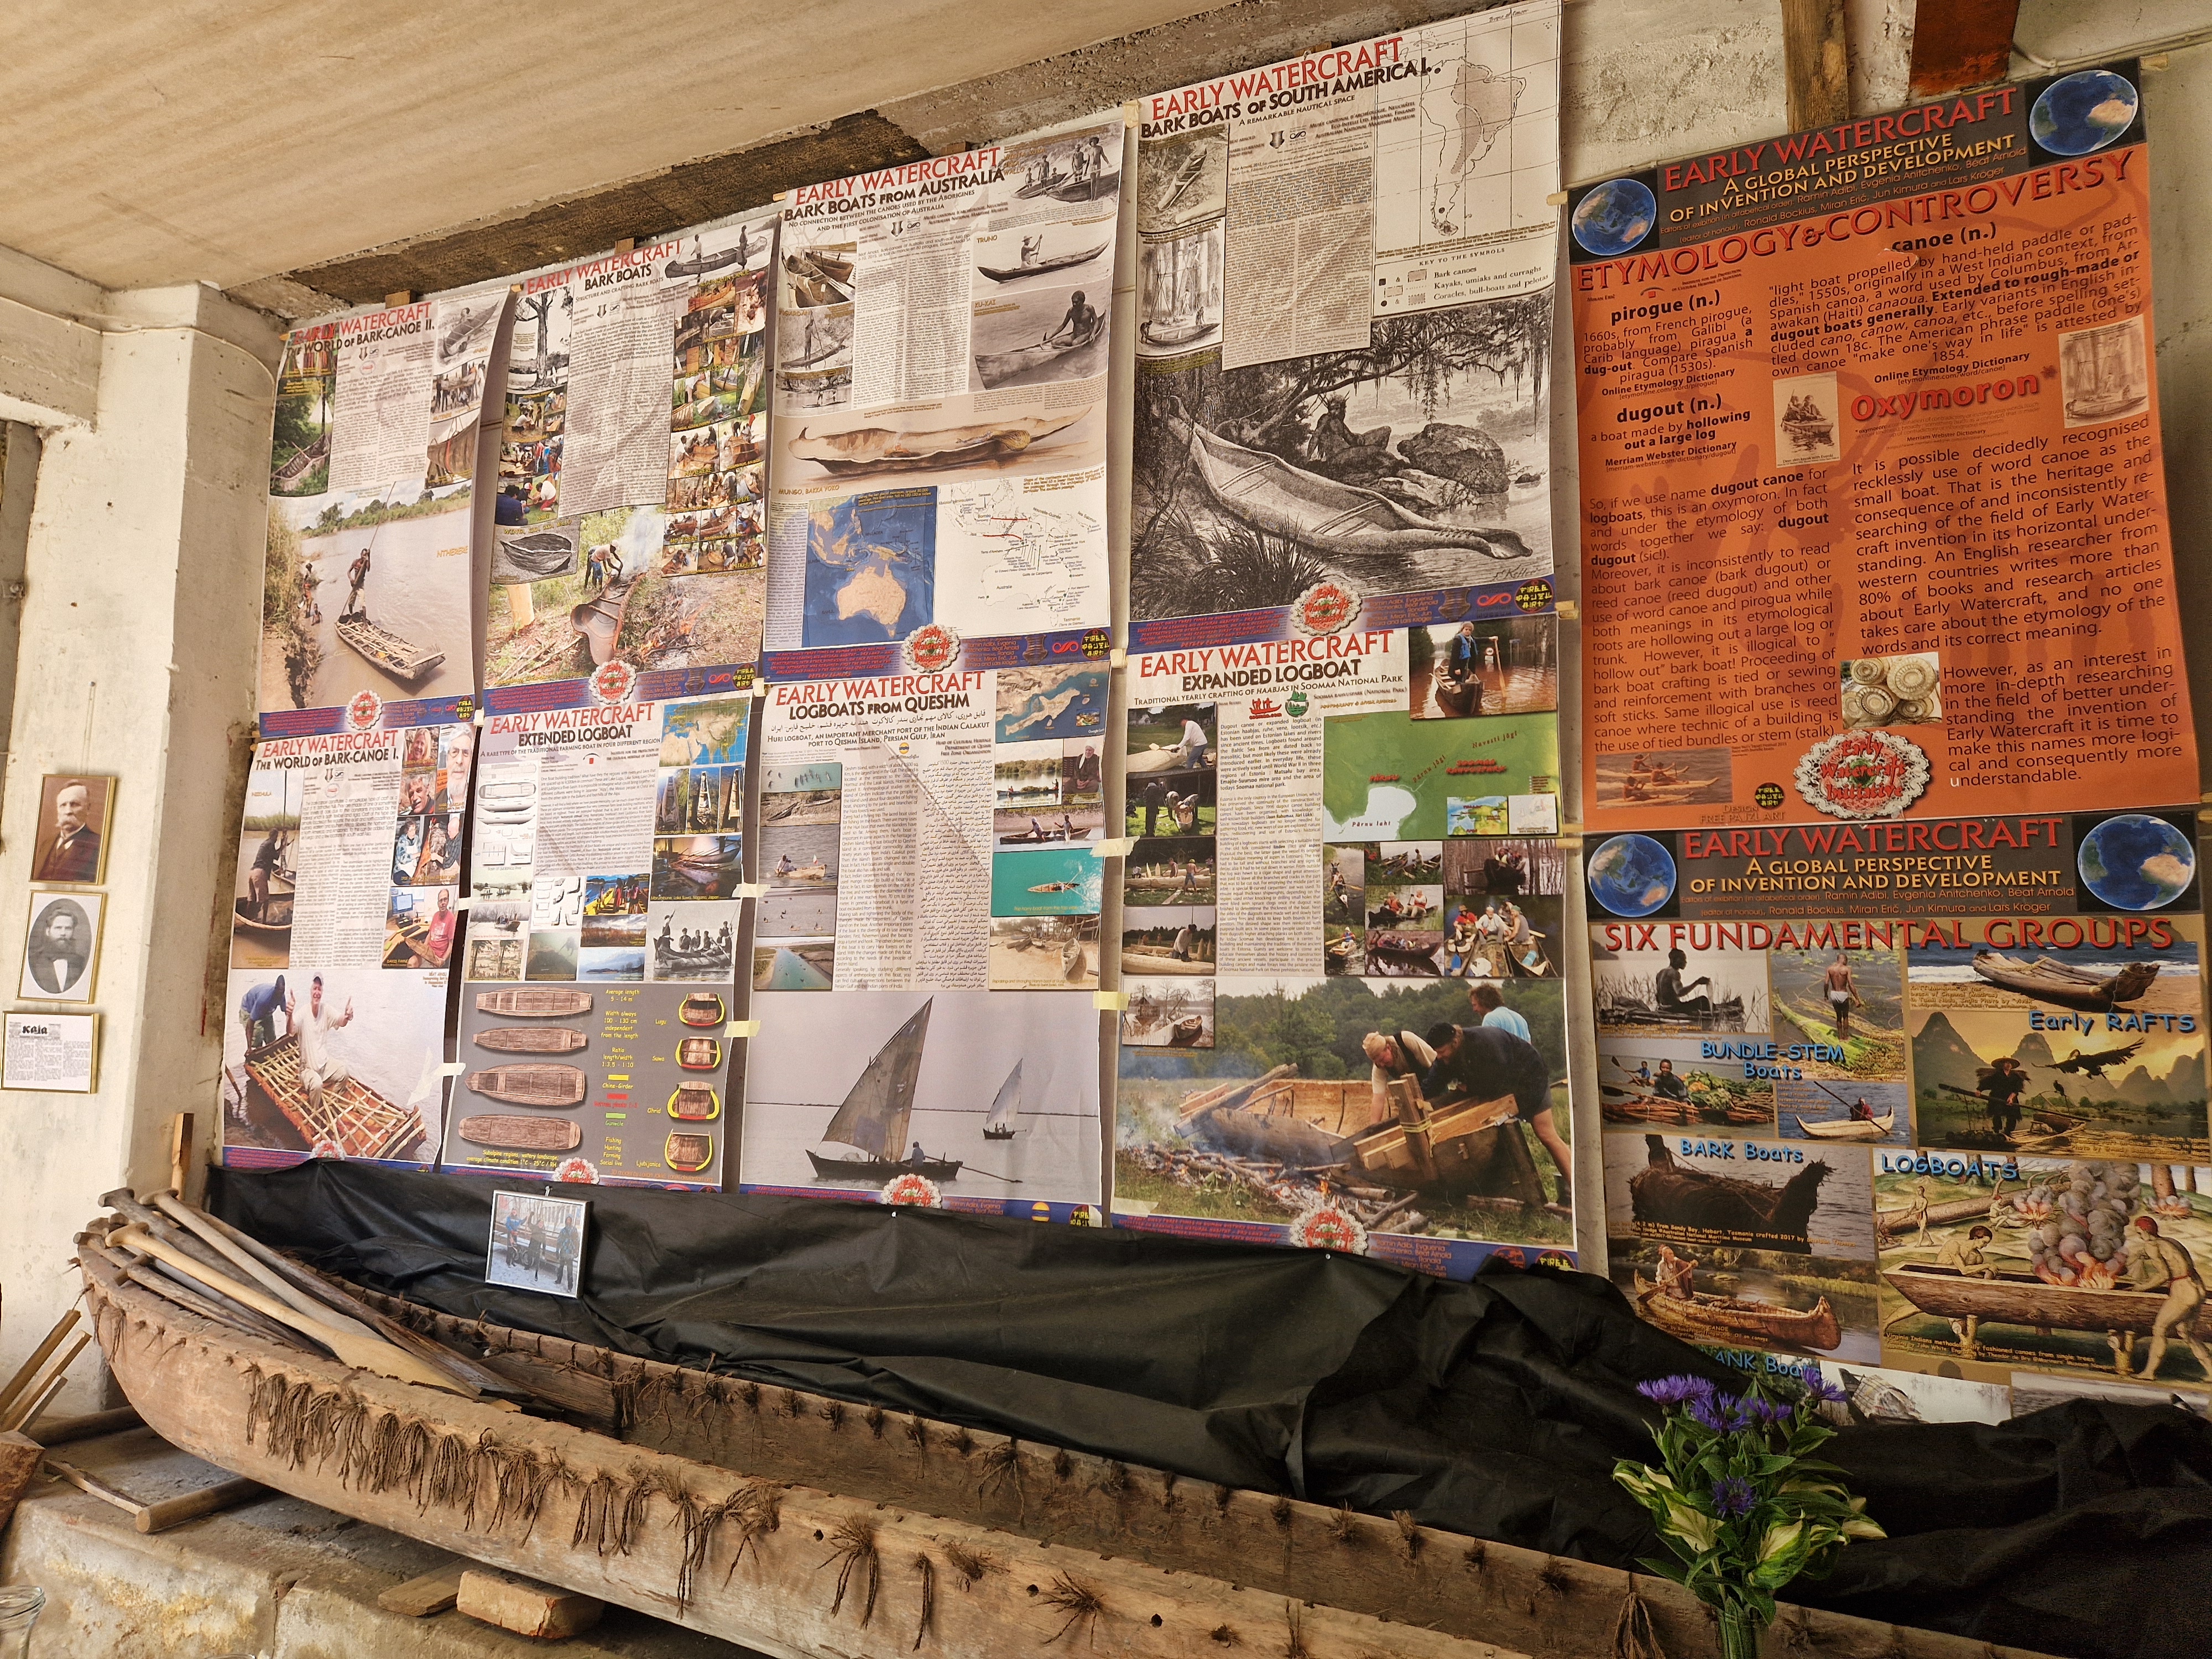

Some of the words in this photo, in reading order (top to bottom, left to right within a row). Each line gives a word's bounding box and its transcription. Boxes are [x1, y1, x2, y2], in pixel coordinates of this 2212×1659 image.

[1152, 82, 1224, 120] EARLY
[1230, 37, 1402, 100] WATERCRAFT
[1141, 114, 1186, 138] BARK
[1189, 102, 1241, 127] BOATS
[1269, 81, 1328, 109] SOUTH
[1331, 60, 1418, 95] AMERICA
[1248, 109, 1294, 124] REMARKABLE
[1297, 101, 1332, 113] NAUTICAL
[1334, 95, 1355, 105] SPACE
[1665, 145, 1764, 191] EARLY
[1773, 89, 2016, 164] WATERCRAFT
[796, 178, 855, 205] EARLY
[862, 147, 1000, 191] WATERCRAFT
[1670, 207, 1693, 221] OF
[1700, 180, 1807, 216] INVENTION
[1814, 170, 1856, 191] AND
[1861, 135, 2016, 185] DEVELOPMENT
[1723, 176, 1739, 195] A
[1745, 163, 1819, 189] GLOBAL
[1825, 134, 1954, 176] PERSPECTIVE
[784, 202, 825, 221] BARK
[828, 193, 875, 214] BOATS
[919, 168, 1005, 197] AUSTRALIA
[1891, 234, 1953, 252] canoe
[1961, 222, 1996, 244] (n.)
[527, 269, 572, 294] EARLY
[576, 239, 680, 278] WATERCRAFT
[1470, 248, 1504, 257] SYMBOLS
[585, 273, 614, 291] BARK
[617, 264, 651, 283] BOATS
[1434, 270, 1450, 278] Bark
[1434, 280, 1462, 289] Kayaks,
[1466, 275, 1490, 284] umiaks
[1510, 267, 1541, 277] curraghs
[1434, 290, 1466, 300] Coracles,
[1470, 285, 1504, 294] bull-boats
[1525, 275, 1550, 288] pelotas
[1611, 301, 1683, 326] pirogue
[1689, 290, 1719, 311] (n.)
[294, 323, 337, 345] EARLY
[340, 302, 431, 334] WATERCRAFT
[1617, 401, 1684, 422] dugout
[1691, 393, 1721, 414] (n.)
[1851, 374, 2037, 420] Oxymoron
[1854, 463, 1862, 475] It
[1875, 460, 1885, 471] is
[1899, 449, 1959, 468] possible
[1973, 436, 2048, 457] decidedly
[2063, 415, 2148, 444] recognised
[1141, 650, 1213, 677] EARLY
[1219, 630, 1393, 668] WATERCRAFT
[1861, 640, 1907, 655] words
[1911, 636, 1939, 650] and
[1945, 635, 1961, 646] its
[1967, 631, 2021, 644] correct
[2026, 623, 2101, 640] meaning.
[776, 682, 838, 705] EARLY
[843, 671, 984, 699] WATERCRAFT
[1182, 666, 1271, 691] EXPANDED
[1275, 659, 1361, 682] LOGBOAT
[491, 714, 540, 734] EARLY
[545, 703, 654, 728] WATERCRAFT
[789, 701, 864, 719] LOGBOATS
[905, 693, 969, 713] QUESHM
[263, 739, 304, 758] EARLY
[307, 730, 398, 752] WATERCRAFT
[519, 730, 575, 747] EXTENDED
[578, 725, 633, 742] LOGBOAT
[274, 756, 310, 769] WORLD
[325, 749, 389, 765] BARK-CANOE
[1950, 769, 2081, 786] understandable.
[1685, 828, 1790, 858] EARLY
[1799, 818, 2063, 853] WATERCRAFT
[1746, 858, 1764, 875] A
[1769, 859, 1848, 874] GLOBAL
[1855, 855, 1991, 872] PERSPECTIVE
[1690, 879, 1715, 892] OF
[1721, 876, 1835, 893] INVENTION
[1843, 875, 1888, 888] AND
[1893, 871, 2060, 891] DEVELOPMENT
[1606, 924, 1657, 950] SIX
[1670, 920, 1970, 950] FUNDAMENTAL
[1984, 917, 2172, 948] GROUPS
[2028, 1010, 2093, 1035] Early
[2105, 1011, 2196, 1034] RAFTS
[1701, 1041, 1845, 1063] BUNDLE-STEM
[1744, 1061, 1804, 1081] Boats
[1681, 1139, 1734, 1158] BARK
[1745, 1142, 1803, 1162] Boats
[1882, 1152, 2021, 1181] LOGBOATS
